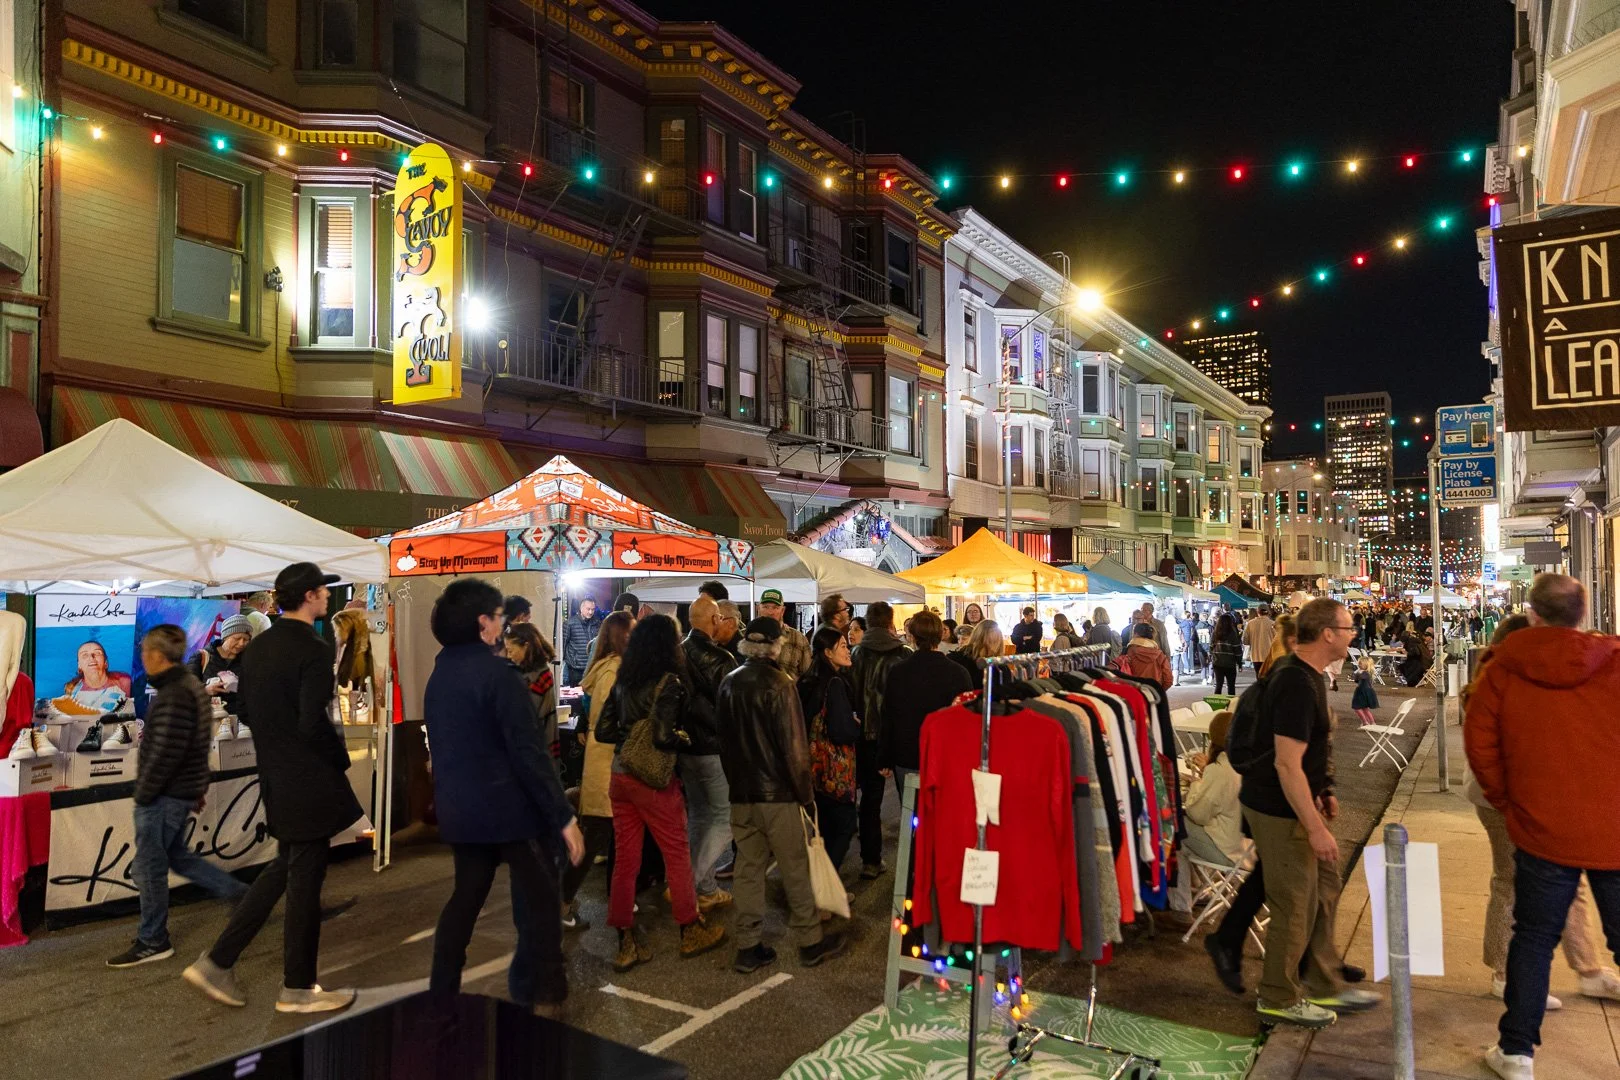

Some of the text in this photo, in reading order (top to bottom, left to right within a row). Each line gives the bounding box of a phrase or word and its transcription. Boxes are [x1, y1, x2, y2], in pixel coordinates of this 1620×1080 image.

[406, 163, 427, 179] THE
[1543, 317, 1568, 333] A
[1544, 339, 1620, 400] LEA
[1442, 411, 1491, 423] Pay here
[1443, 460, 1479, 471] Pay by
[1444, 469, 1483, 479] License
[1444, 478, 1471, 487] Plate
[1446, 489, 1492, 498] 44414003
[425, 507, 449, 519] THE
[419, 555, 499, 569] Stay Up Movement
[644, 553, 714, 568] Stay Up Movement
